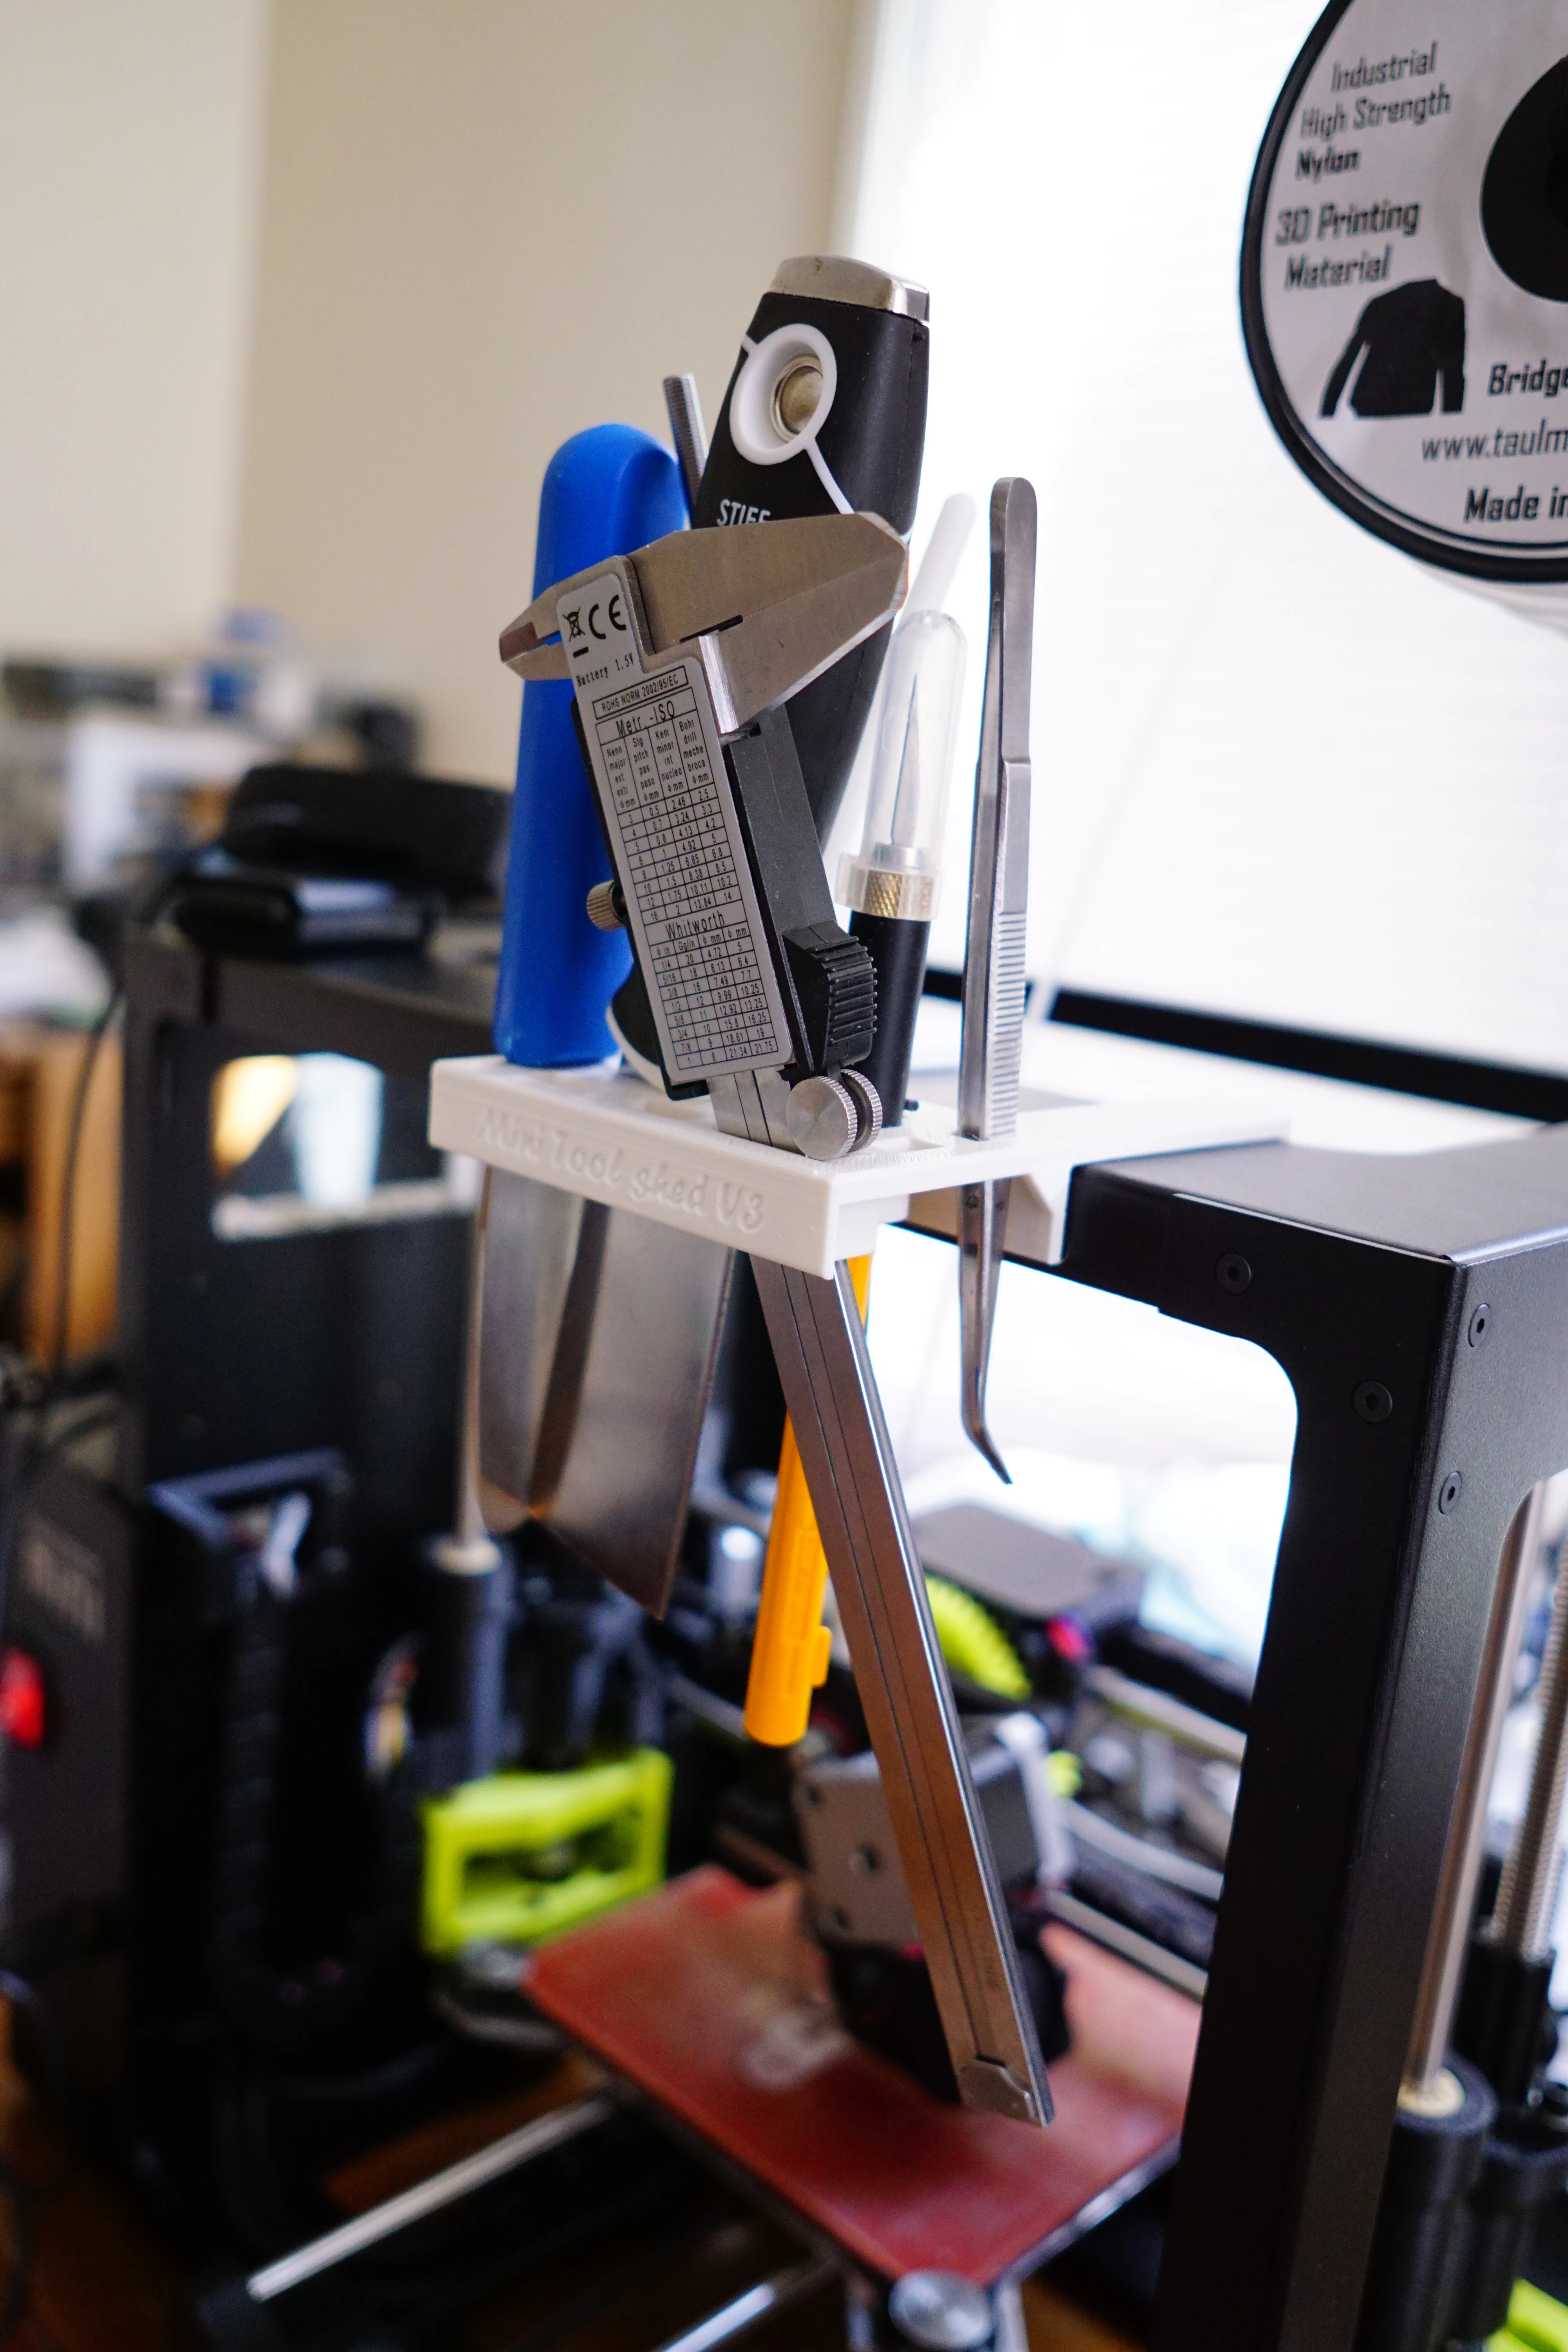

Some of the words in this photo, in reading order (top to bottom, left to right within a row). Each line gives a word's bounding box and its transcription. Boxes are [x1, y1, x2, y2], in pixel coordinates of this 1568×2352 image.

[1332, 40, 1438, 93] Industrial
[1300, 101, 1347, 141] High
[1354, 82, 1452, 130] Strength
[1296, 147, 1361, 181] Nylon
[1276, 207, 1312, 245] 3D
[1318, 199, 1421, 237] Printing
[1284, 243, 1393, 290] Material
[1422, 418, 1568, 462] www.taulm
[1464, 485, 1540, 523] Made
[576, 667, 608, 687] Battery
[615, 653, 633, 671] 1.5V
[601, 698, 619, 711] ROHS
[621, 689, 640, 705] NORM
[642, 674, 678, 697] 2002/95/EC
[679, 719, 694, 731] Bohr
[684, 731, 697, 744] drill
[606, 746, 622, 757] Nenn
[632, 737, 643, 748] Stg
[657, 741, 673, 753] minor
[683, 746, 703, 759] meche
[610, 759, 625, 770] major
[634, 749, 648, 764] pitch
[664, 755, 673, 765] int
[687, 759, 705, 771] broca
[615, 773, 624, 784] ext
[639, 765, 650, 777] pas
[661, 768, 682, 781] nucleo
[698, 773, 709, 783] mm
[617, 786, 628, 797] extr
[641, 778, 655, 791] paso
[649, 791, 659, 800] mm
[673, 782, 684, 791] mm
[625, 799, 635, 808] mm
[628, 814, 633, 824] 3
[649, 805, 659, 817] 0.5
[671, 797, 686, 810] 2.46
[698, 788, 709, 801] 2.5
[633, 828, 636, 837] 4
[652, 819, 662, 831] 0.7
[675, 811, 689, 824] 3.24
[702, 803, 712, 815] 3.3
[635, 842, 640, 851] 5
[656, 833, 666, 845] 0.8
[679, 825, 692, 838] 4.13
[706, 818, 716, 829] 4.2
[639, 856, 643, 866] 6
[662, 848, 666, 858] 1
[682, 839, 696, 852] 4.92
[711, 833, 716, 843] 5
[661, 861, 675, 873] 1.25
[685, 853, 699, 866] 6.65
[712, 847, 722, 858] 6.8
[644, 883, 652, 894] 10
[666, 876, 676, 887] 1.5
[689, 868, 702, 881] 8.38
[715, 861, 726, 873] 8.5
[647, 897, 655, 907] 12
[668, 889, 682, 902] 1.75
[690, 882, 708, 895] 10.11
[717, 875, 732, 888] 10.2
[651, 911, 658, 920] 16
[675, 905, 681, 915] 2
[694, 897, 711, 909] 13.84
[724, 891, 731, 901] 14
[665, 911, 725, 939] Whitworth
[710, 934, 721, 942] mm
[736, 927, 747, 936] mm
[661, 960, 670, 970] 1/4
[686, 953, 694, 964] 20
[708, 947, 722, 958] 4.72
[737, 942, 742, 951] 5
[662, 973, 676, 984] 5/16
[690, 967, 697, 978] 18
[711, 961, 725, 973] 6.13
[738, 956, 748, 967] 6.4
[668, 987, 677, 998] 3/8
[693, 982, 701, 991] 16
[714, 975, 728, 987] 7.49
[741, 969, 751, 981] 7.7
[671, 1001, 681, 1011] 1/2
[696, 996, 704, 1005] 12
[717, 989, 731, 1001] 9.99
[741, 983, 759, 996] 10.25
[674, 1014, 684, 1025] 5/8
[700, 1010, 707, 1020] 11
[719, 1003, 737, 1015] 12.92
[744, 998, 762, 1010] 13.25
[678, 1029, 688, 1039] 3/4
[703, 1024, 711, 1034] 10
[725, 1018, 739, 1029] 15.8
[748, 1012, 766, 1024] 16.25
[681, 1042, 691, 1052] 7/8
[708, 1038, 712, 1047] 9
[726, 1032, 743, 1043] 18.61
[757, 1027, 764, 1038] 19
[711, 1052, 715, 1061] 8
[729, 1046, 747, 1058] 21.34
[754, 1041, 773, 1053] 21.75
[550, 1130, 625, 1188] Tool
[628, 1161, 709, 1217] shed
[716, 1181, 764, 1234] V3
